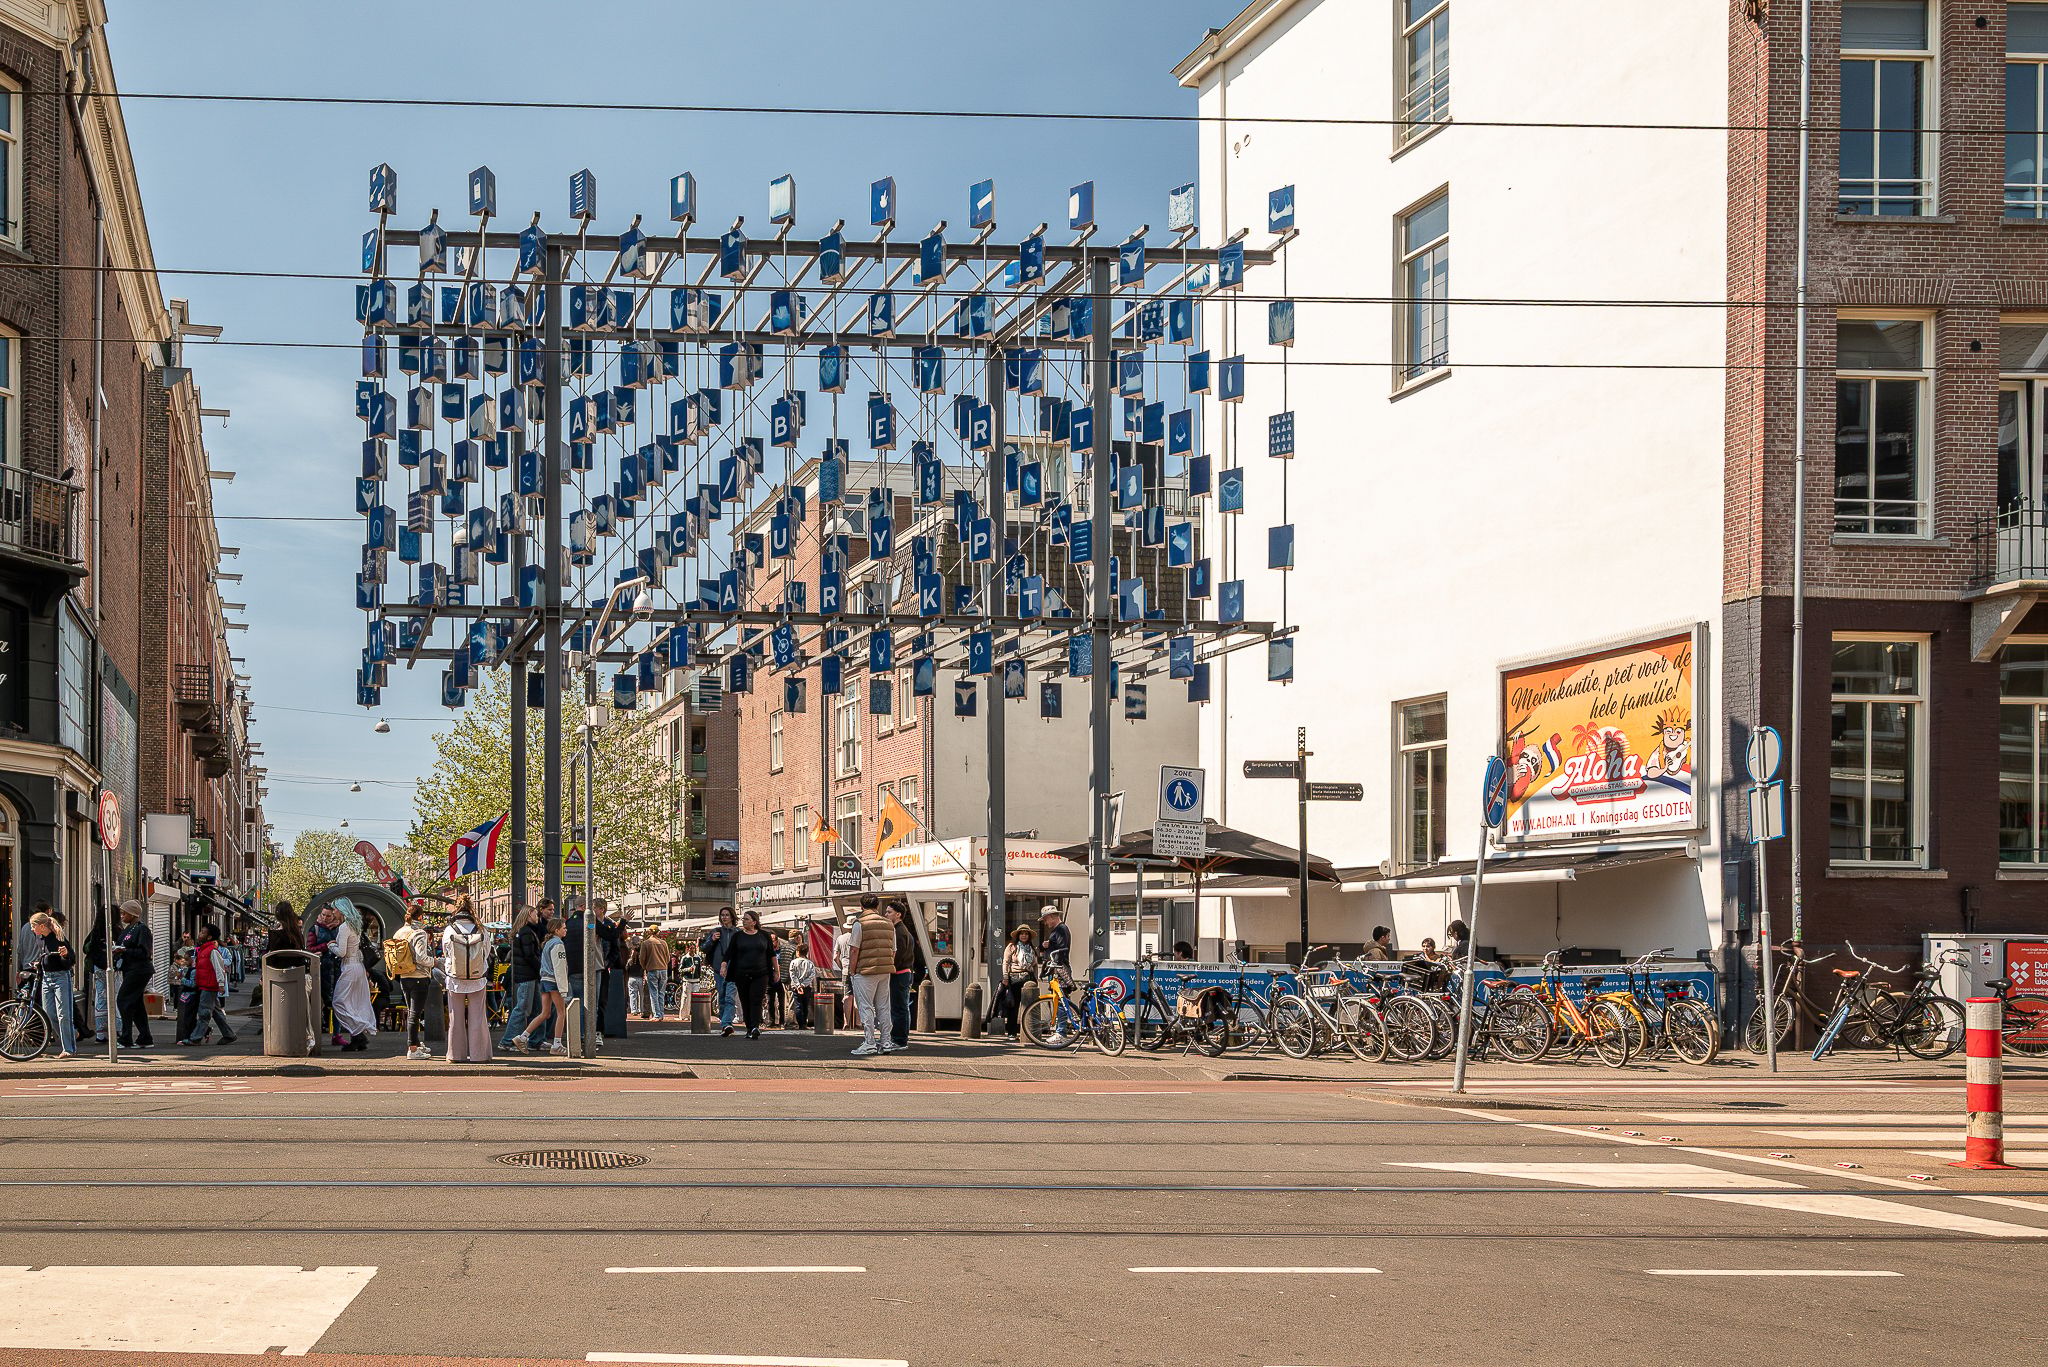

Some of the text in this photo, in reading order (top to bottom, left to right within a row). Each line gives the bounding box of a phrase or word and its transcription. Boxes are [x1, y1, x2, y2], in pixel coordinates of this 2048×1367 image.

[1511, 643, 1692, 713] Meivakantie, pret voor de
[1590, 668, 1683, 720] hele familie!
[1173, 769, 1193, 777] ZONE
[1552, 749, 1640, 795] Aloha
[1600, 780, 1639, 791] RESTAURANT
[105, 809, 118, 831] 30
[1512, 813, 1577, 833] WWW.ALOHA.NL
[1590, 808, 1639, 825] Koningsdag
[1642, 800, 1692, 819] GESLOTEN
[830, 870, 861, 879] ASIAN
[830, 878, 861, 886] MARKET
[779, 881, 806, 899] MARKET
